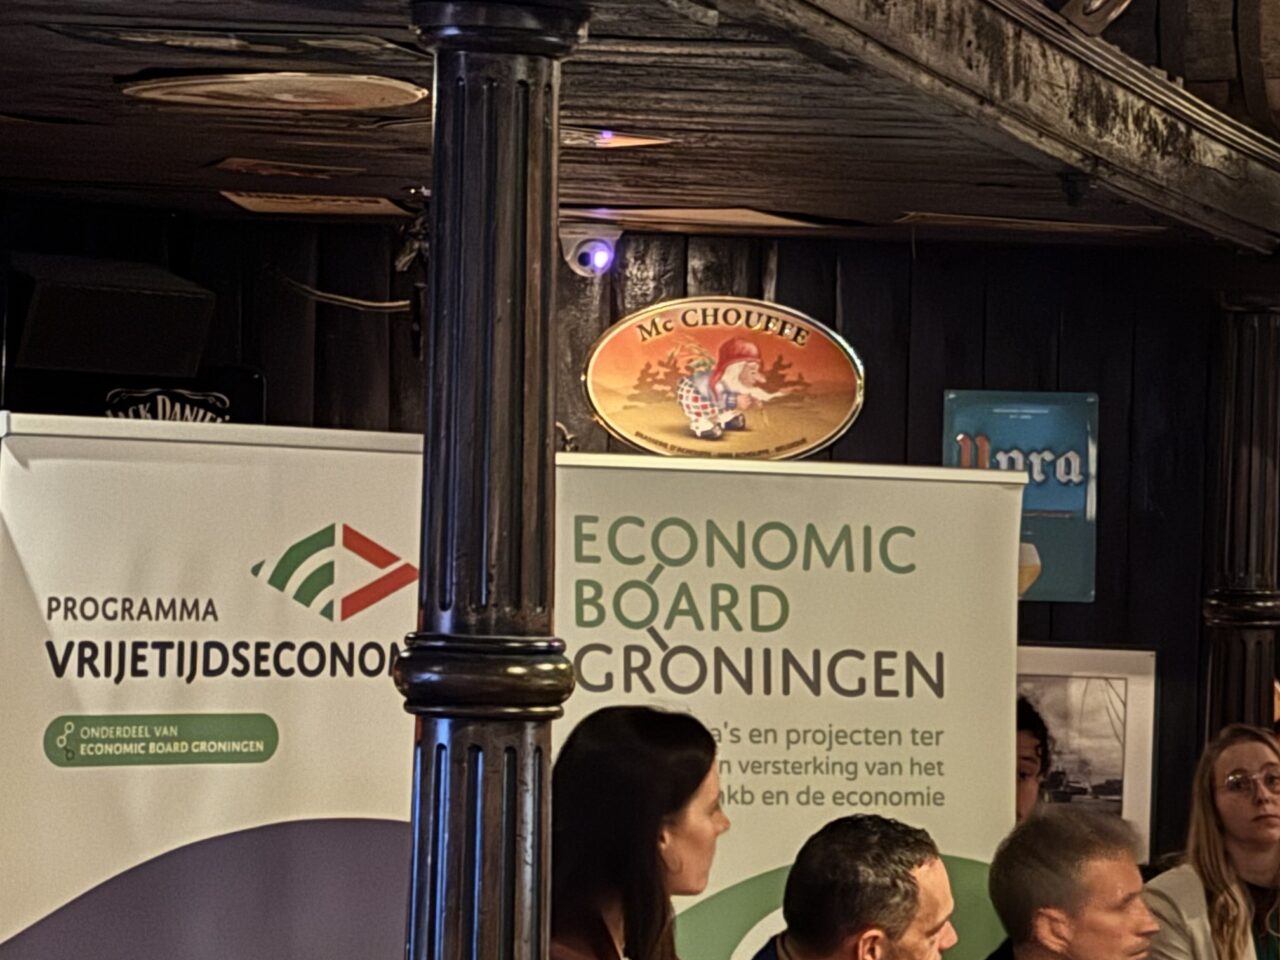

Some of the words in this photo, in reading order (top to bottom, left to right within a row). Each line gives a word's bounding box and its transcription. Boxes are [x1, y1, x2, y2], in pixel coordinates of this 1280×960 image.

[636, 318, 674, 342] Mc
[681, 307, 810, 347] CHOUFFE
[574, 515, 917, 574] ECONOMIC
[47, 597, 219, 622] PROGRAMMA
[574, 579, 790, 634] BOARD
[573, 642, 946, 699] GRONINGEN
[80, 726, 151, 739] ONDERDEEL
[154, 725, 178, 738] VAN
[710, 721, 741, 744] a's
[749, 728, 777, 744] en
[785, 723, 902, 751] projecten
[911, 727, 944, 746] ter
[80, 742, 146, 756] ECONOMIC
[149, 741, 189, 755] BOARD
[191, 740, 264, 754] GRONINGEN
[718, 759, 731, 774] n
[738, 756, 858, 781] versterking
[865, 761, 902, 776] van
[910, 757, 944, 776] het
[762, 789, 788, 805] en
[796, 785, 824, 806] de
[832, 787, 945, 806] economie
